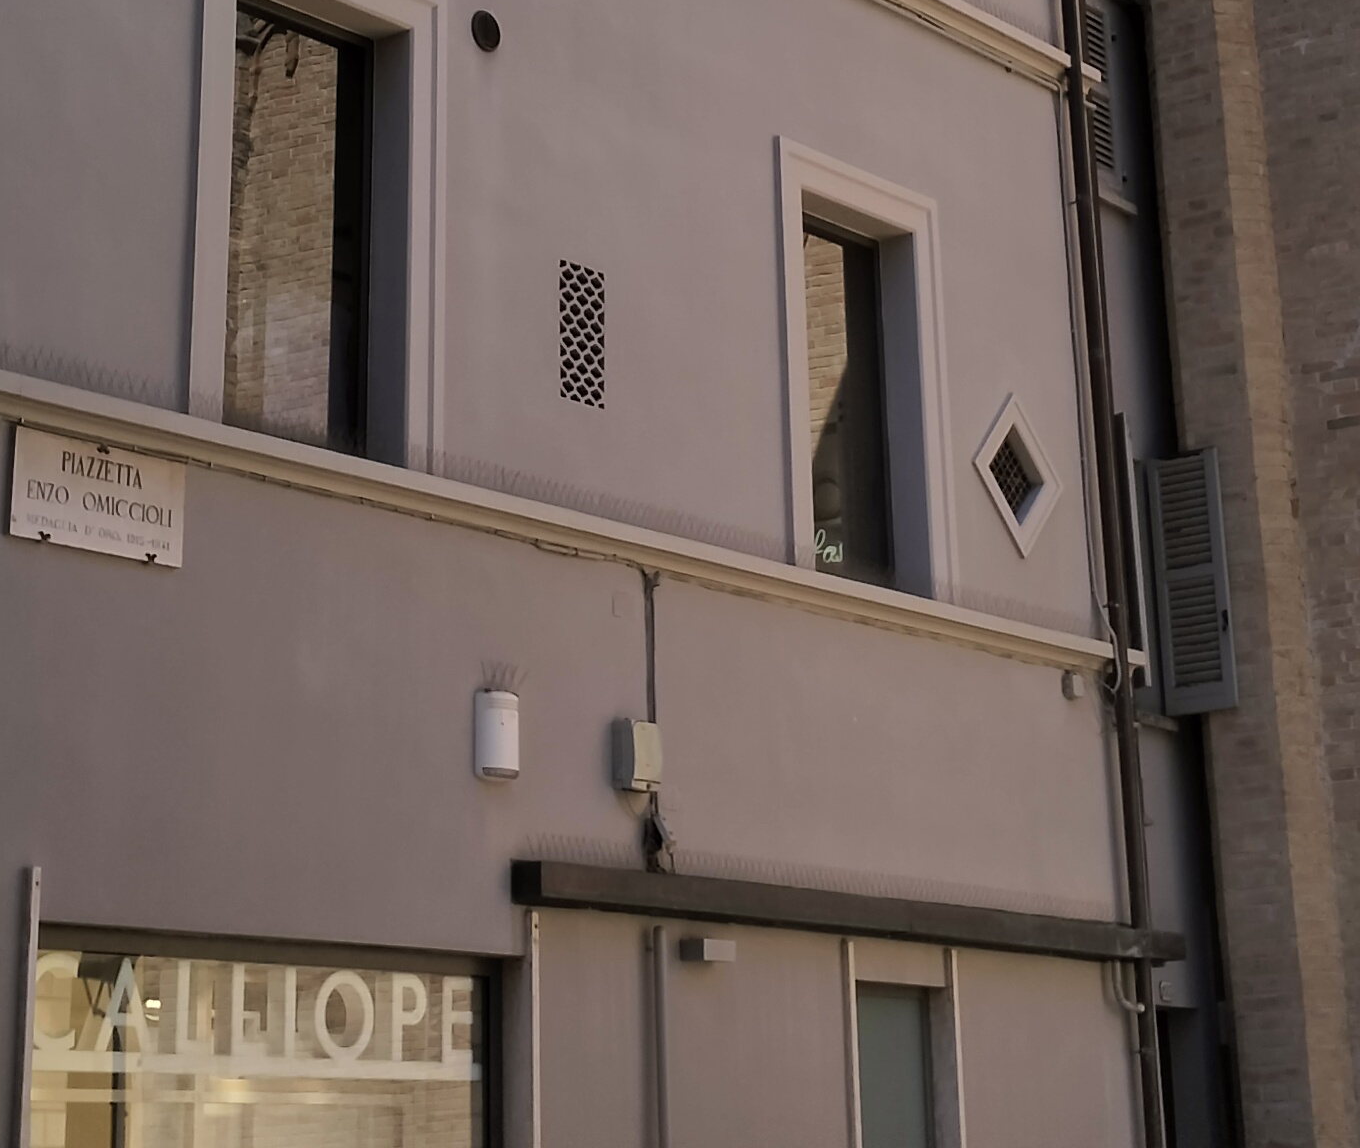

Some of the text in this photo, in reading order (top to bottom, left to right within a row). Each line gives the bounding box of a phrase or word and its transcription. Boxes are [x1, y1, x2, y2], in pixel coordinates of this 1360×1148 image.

[61, 450, 143, 490] PIAZZETTA
[27, 479, 173, 528] ENZO OMICCIOLI
[31, 950, 474, 1064] CALLIOPE
